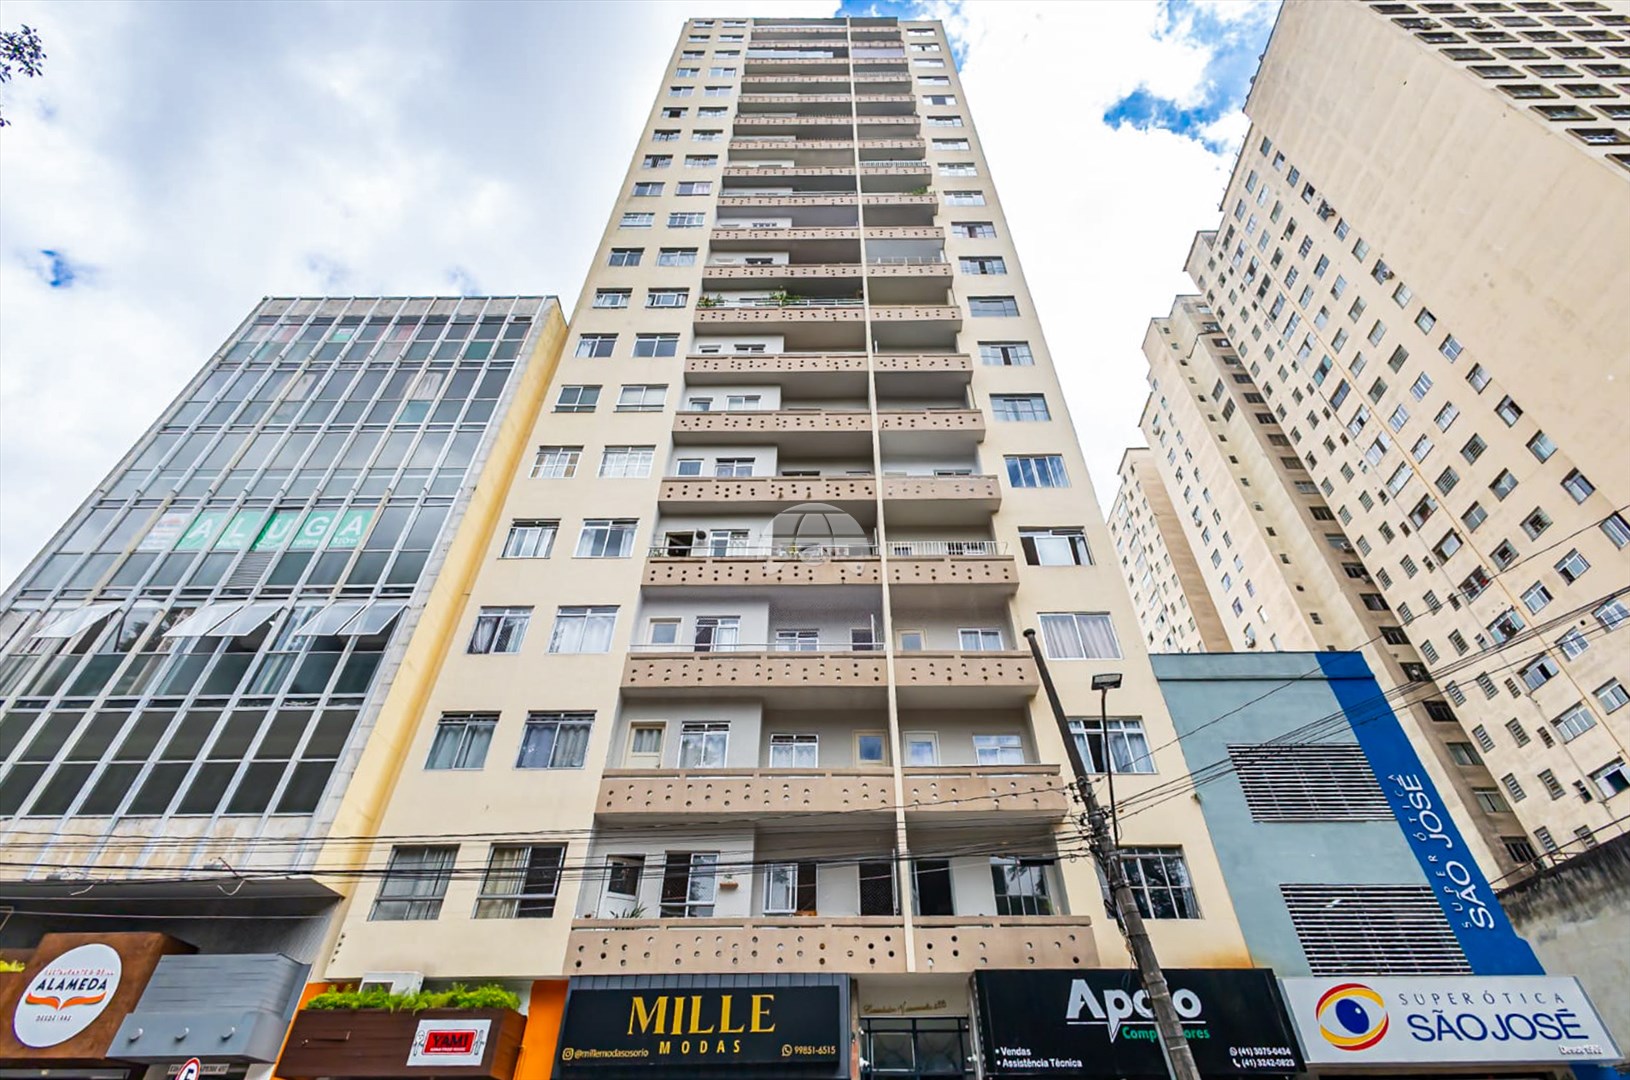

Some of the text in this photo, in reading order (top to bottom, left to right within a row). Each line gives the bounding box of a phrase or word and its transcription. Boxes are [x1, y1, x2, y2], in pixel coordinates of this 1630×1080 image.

[187, 515, 363, 539] ALUGA
[1396, 773, 1495, 929] SÃO JOSÉ
[35, 977, 108, 991] ALAMEDA
[627, 994, 776, 1035] MILLE
[1407, 1009, 1589, 1042] SÃO JOSÉ
[659, 1039, 740, 1055] MODAS
[1000, 1047, 1031, 1056] Vendas
